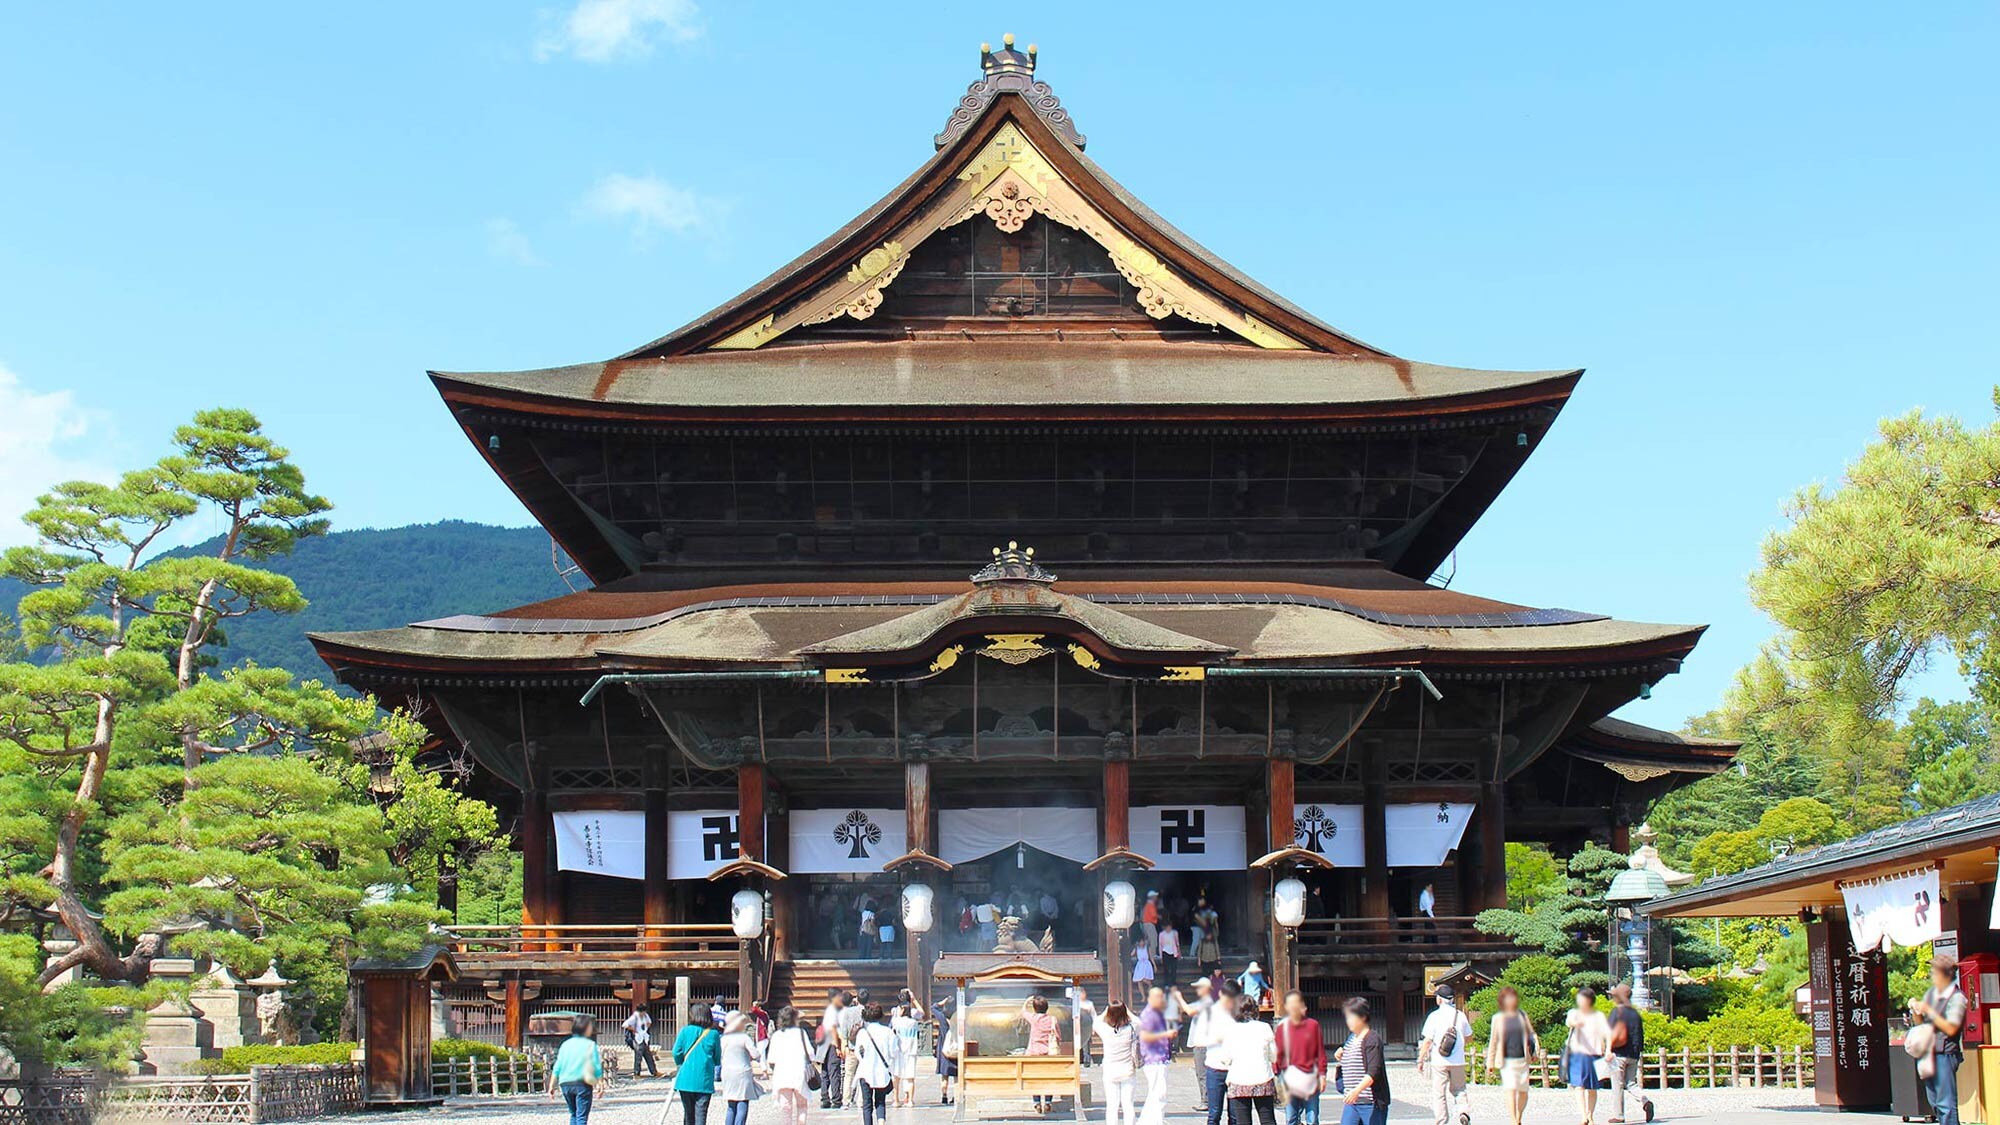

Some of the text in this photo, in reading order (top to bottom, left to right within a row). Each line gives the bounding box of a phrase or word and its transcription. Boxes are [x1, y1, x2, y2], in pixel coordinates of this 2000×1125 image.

[1437, 802, 1449, 823] 奉納
[1857, 1035, 1869, 1070] 受付中
